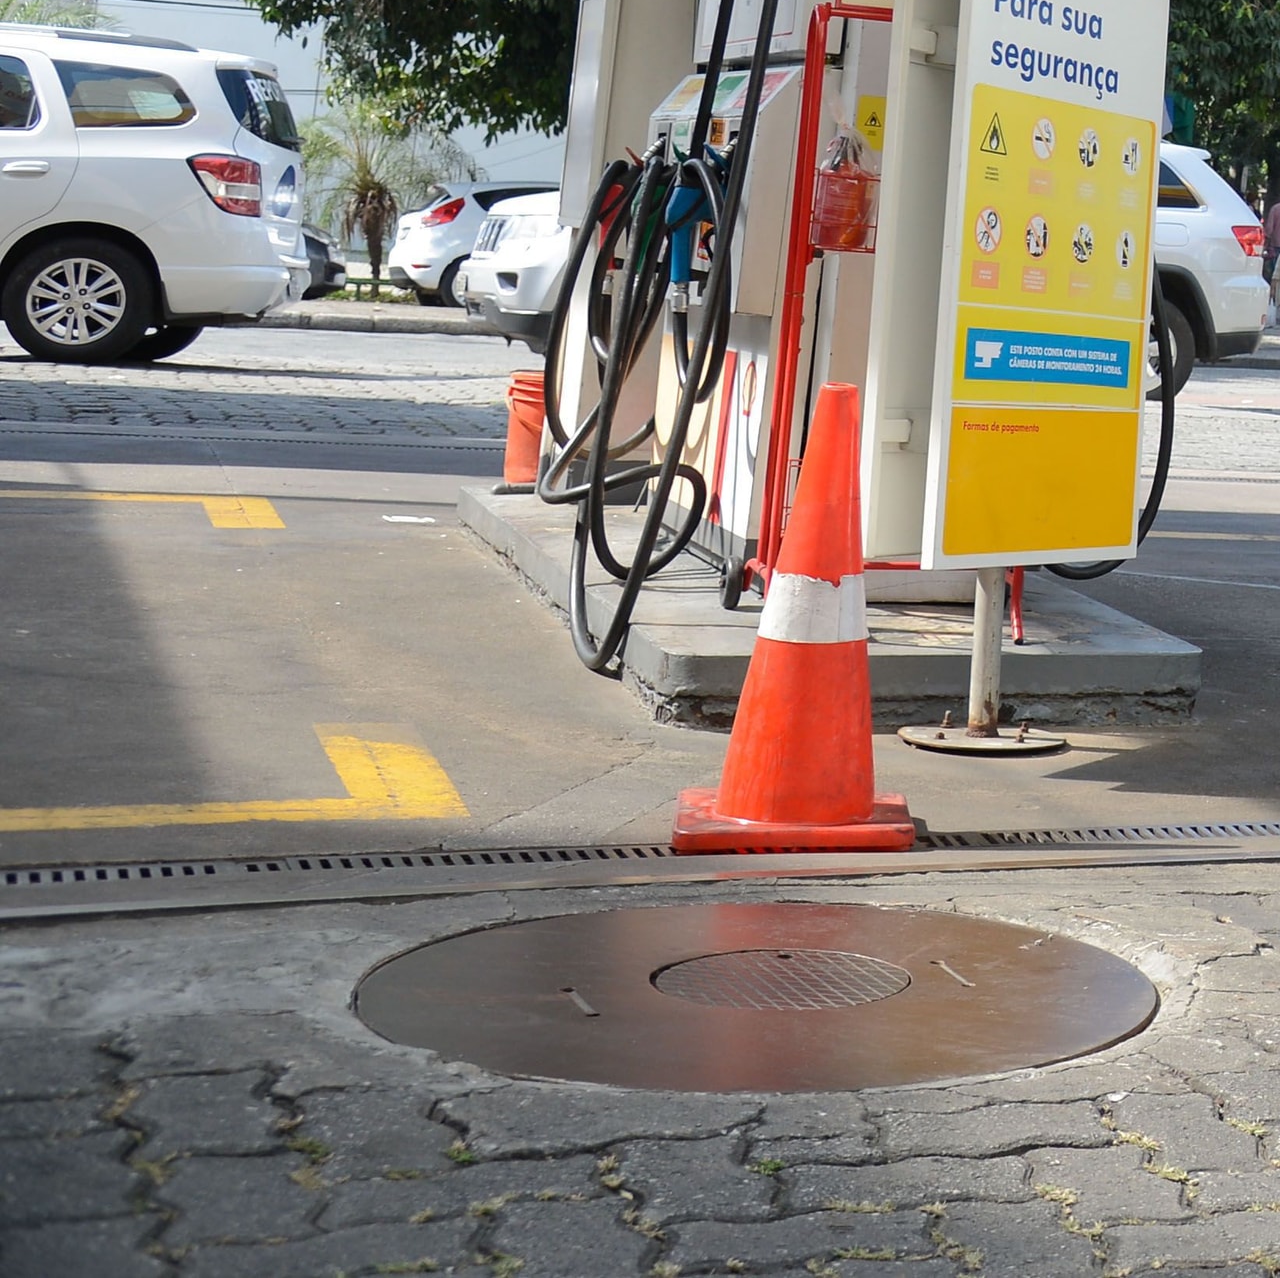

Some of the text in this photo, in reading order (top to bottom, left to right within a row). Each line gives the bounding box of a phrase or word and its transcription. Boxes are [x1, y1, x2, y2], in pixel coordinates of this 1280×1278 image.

[1061, 6, 1103, 40] sua
[991, 40, 1118, 100] segurança
[1010, 345, 1117, 362] ESTE POSTO CONTA COM UM SISTEMA DE
[1009, 357, 1036, 369] CÂMERAS
[1037, 360, 1045, 369] DE
[1046, 361, 1094, 373] MONITORAMENTO
[963, 421, 1039, 434] Formas de pagamento
